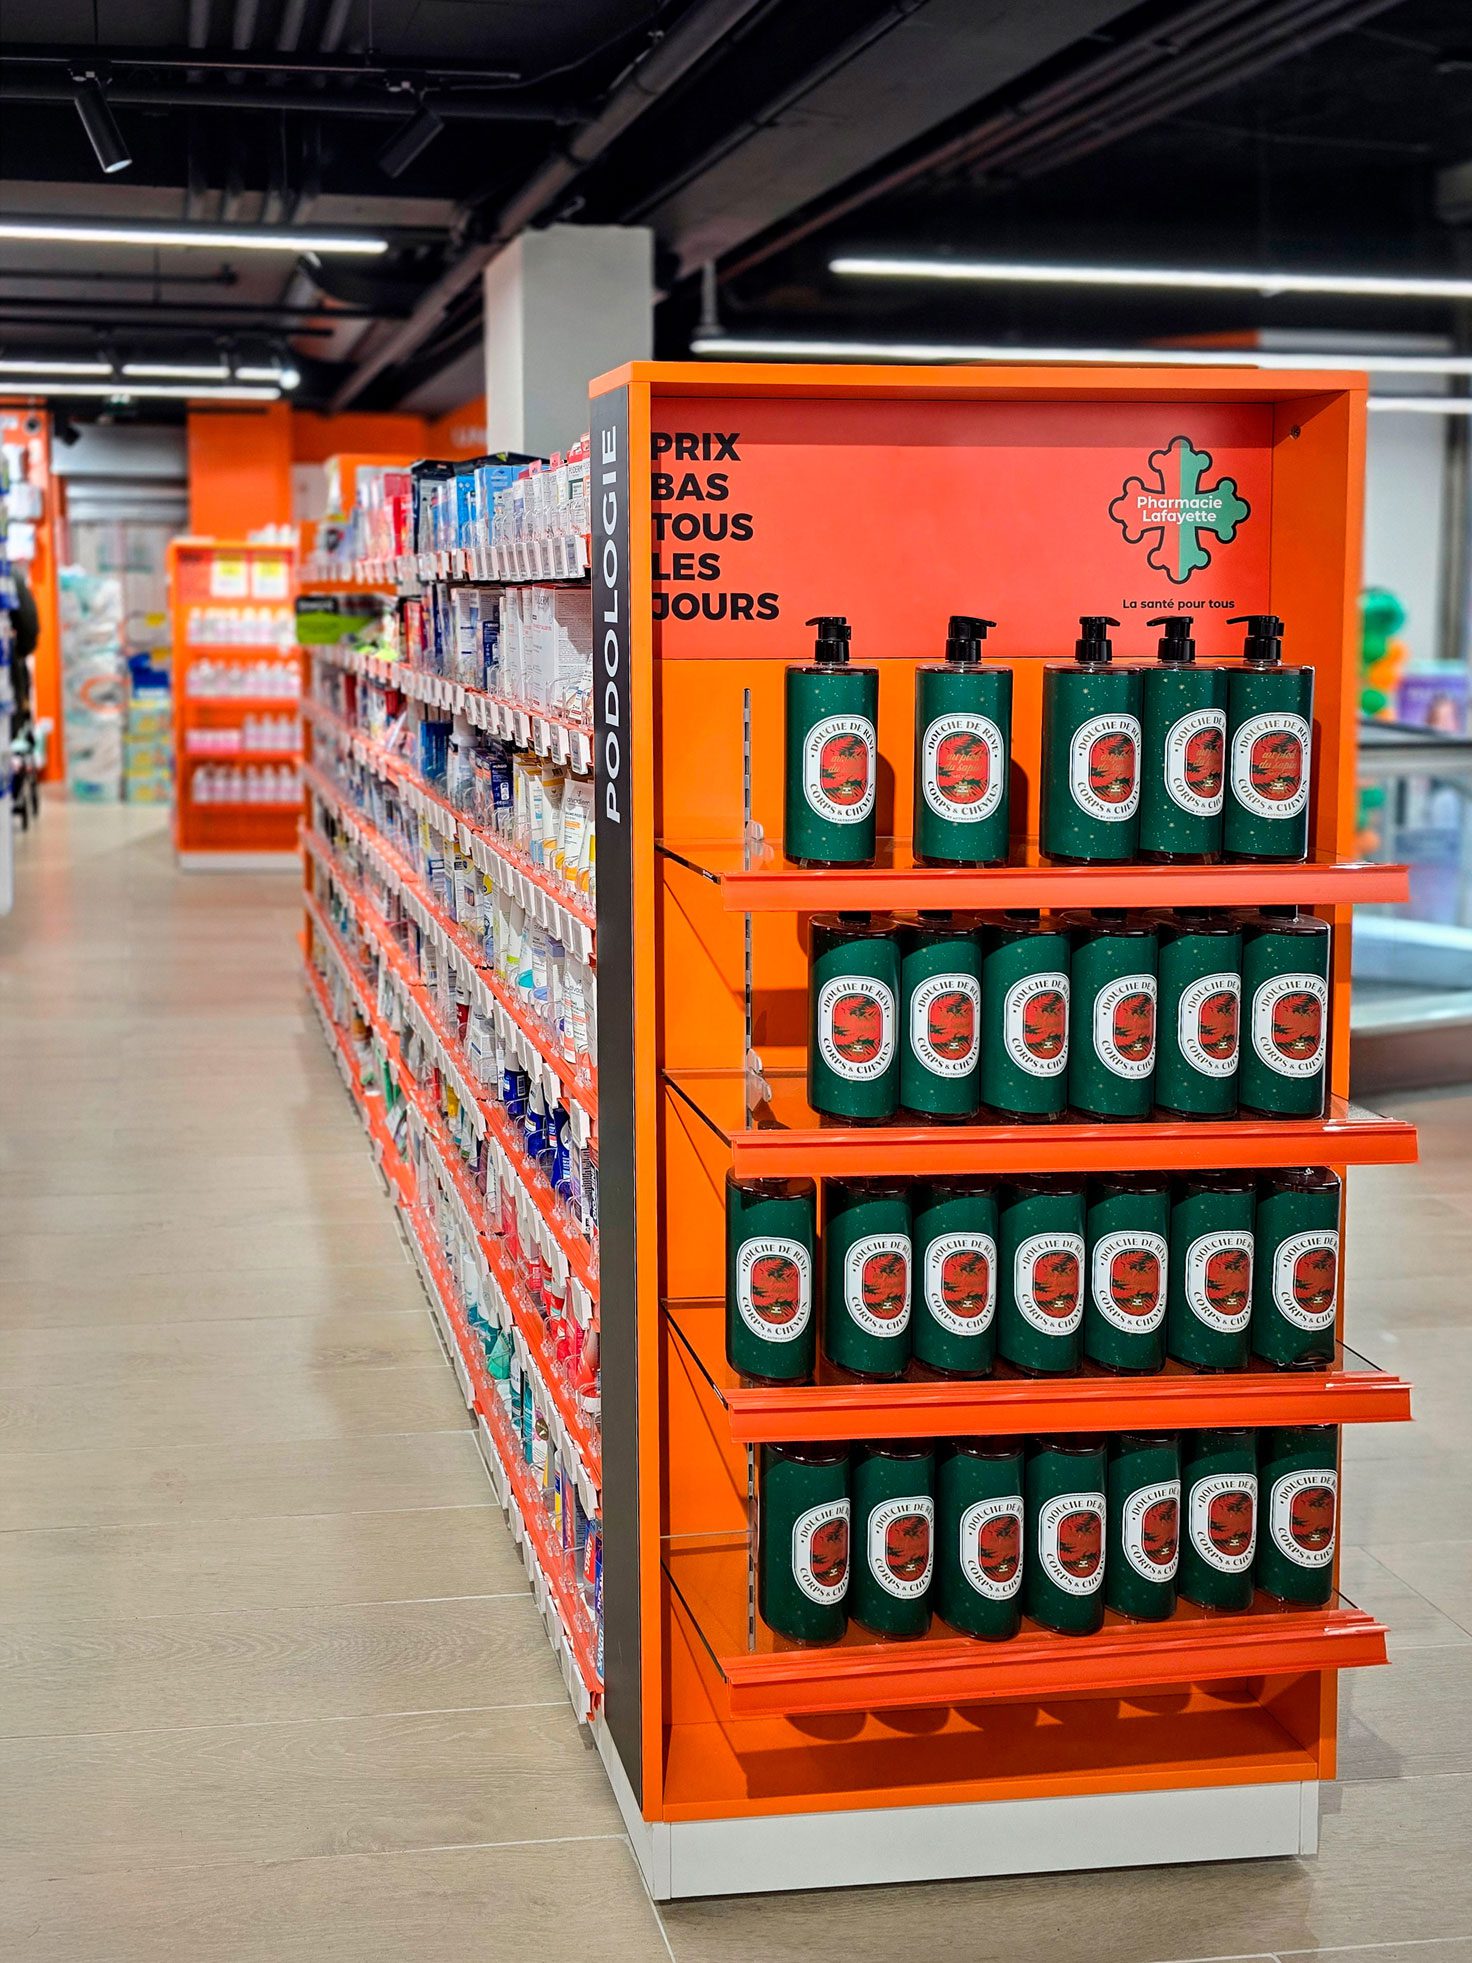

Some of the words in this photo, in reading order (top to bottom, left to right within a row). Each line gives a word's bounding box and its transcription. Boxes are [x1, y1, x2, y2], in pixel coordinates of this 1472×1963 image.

[650, 432, 741, 461] PRIX
[651, 472, 729, 501] BAS
[1137, 496, 1223, 509] Pharmacie
[1142, 510, 1217, 524] Lafayette
[651, 513, 754, 541] TOUS
[651, 553, 721, 581] LES
[651, 592, 780, 621] JOURS
[1123, 600, 1137, 608] La
[1140, 599, 1174, 608] santé
[1177, 601, 1207, 610] pour
[1209, 600, 1235, 608] tous
[602, 425, 621, 824] PODOLOGIE
[811, 723, 847, 751] DOUCHE
[850, 723, 862, 732] DE
[928, 721, 963, 749] DOUCHE
[966, 721, 982, 730] DE
[982, 728, 999, 752] RÊVE
[1078, 721, 1117, 750] DOUCHE
[1120, 721, 1131, 730] DE
[1174, 716, 1212, 746] DOUCHE
[1240, 720, 1280, 748] DOUCHE
[1284, 720, 1297, 729] DE
[810, 784, 836, 814] CORPS
[928, 781, 951, 812] CORPS
[962, 784, 999, 815] CHEVEUX
[1078, 782, 1104, 812] CORPS
[1174, 778, 1199, 807] CORPS
[1239, 779, 1265, 809] CORPS
[824, 983, 857, 1008] DOUCHE
[861, 984, 875, 992] DE
[876, 990, 890, 1012] RÊVE
[918, 981, 954, 1007] DOUCHE
[957, 981, 968, 989] DE
[1013, 980, 1048, 1008] DOUCHE
[1102, 982, 1138, 1010] DOUCHE
[1188, 981, 1224, 1009] DOUCHE
[1262, 981, 1301, 1007] DOUCHE
[1305, 981, 1316, 990] DE
[824, 1037, 846, 1070] CORPS
[856, 1042, 890, 1074] CHEVEUX
[918, 1037, 944, 1068] CORPS
[1012, 1038, 1038, 1067] CORPS
[1102, 1040, 1128, 1070] CORPS
[1187, 1039, 1213, 1068] CORPS
[1261, 1036, 1287, 1067] CORPS
[743, 1244, 775, 1268] DOUCHE
[779, 1245, 791, 1254] DE
[793, 1252, 808, 1272] RÊVE
[853, 1241, 890, 1267] DOUCHE
[891, 1241, 901, 1249] DE
[932, 1239, 968, 1264] DOUCHE
[971, 1240, 983, 1248] DE
[1023, 1240, 1060, 1264] DOUCHE
[1063, 1240, 1073, 1248] DE
[1100, 1237, 1138, 1261] DOUCHE
[1142, 1239, 1154, 1248] DE
[1195, 1238, 1233, 1263] DOUCHE
[1283, 1237, 1321, 1262] DOUCHE
[1324, 1237, 1333, 1245] DE
[742, 1297, 765, 1331] CORPS
[775, 1301, 807, 1335] CHEVEUX
[852, 1297, 876, 1328] CORPS
[932, 1293, 956, 1324] CORPS
[1022, 1294, 1048, 1325] CORPS
[1099, 1290, 1125, 1323] CORPS
[1194, 1291, 1221, 1323] CORPS
[1282, 1292, 1308, 1322] CORPS
[1132, 1489, 1167, 1515] DOUCHE
[1198, 1481, 1234, 1503] DOUCHE
[1279, 1477, 1317, 1500] DOUCHE
[800, 1509, 834, 1538] DOUCHE
[876, 1504, 911, 1529] DOUCHE
[969, 1505, 1003, 1530] DOUCHE
[1006, 1504, 1016, 1512] DE
[1047, 1500, 1083, 1524] DOUCHE
[584, 1536, 592, 1574] START
[1197, 1531, 1224, 1563] CORPS
[1279, 1527, 1305, 1558] CORPS
[875, 1558, 900, 1589] CORPS
[1047, 1553, 1072, 1586] CORPS
[1131, 1545, 1155, 1574] CORPS
[800, 1568, 824, 1596] CORPS
[968, 1560, 993, 1591] CORPS
